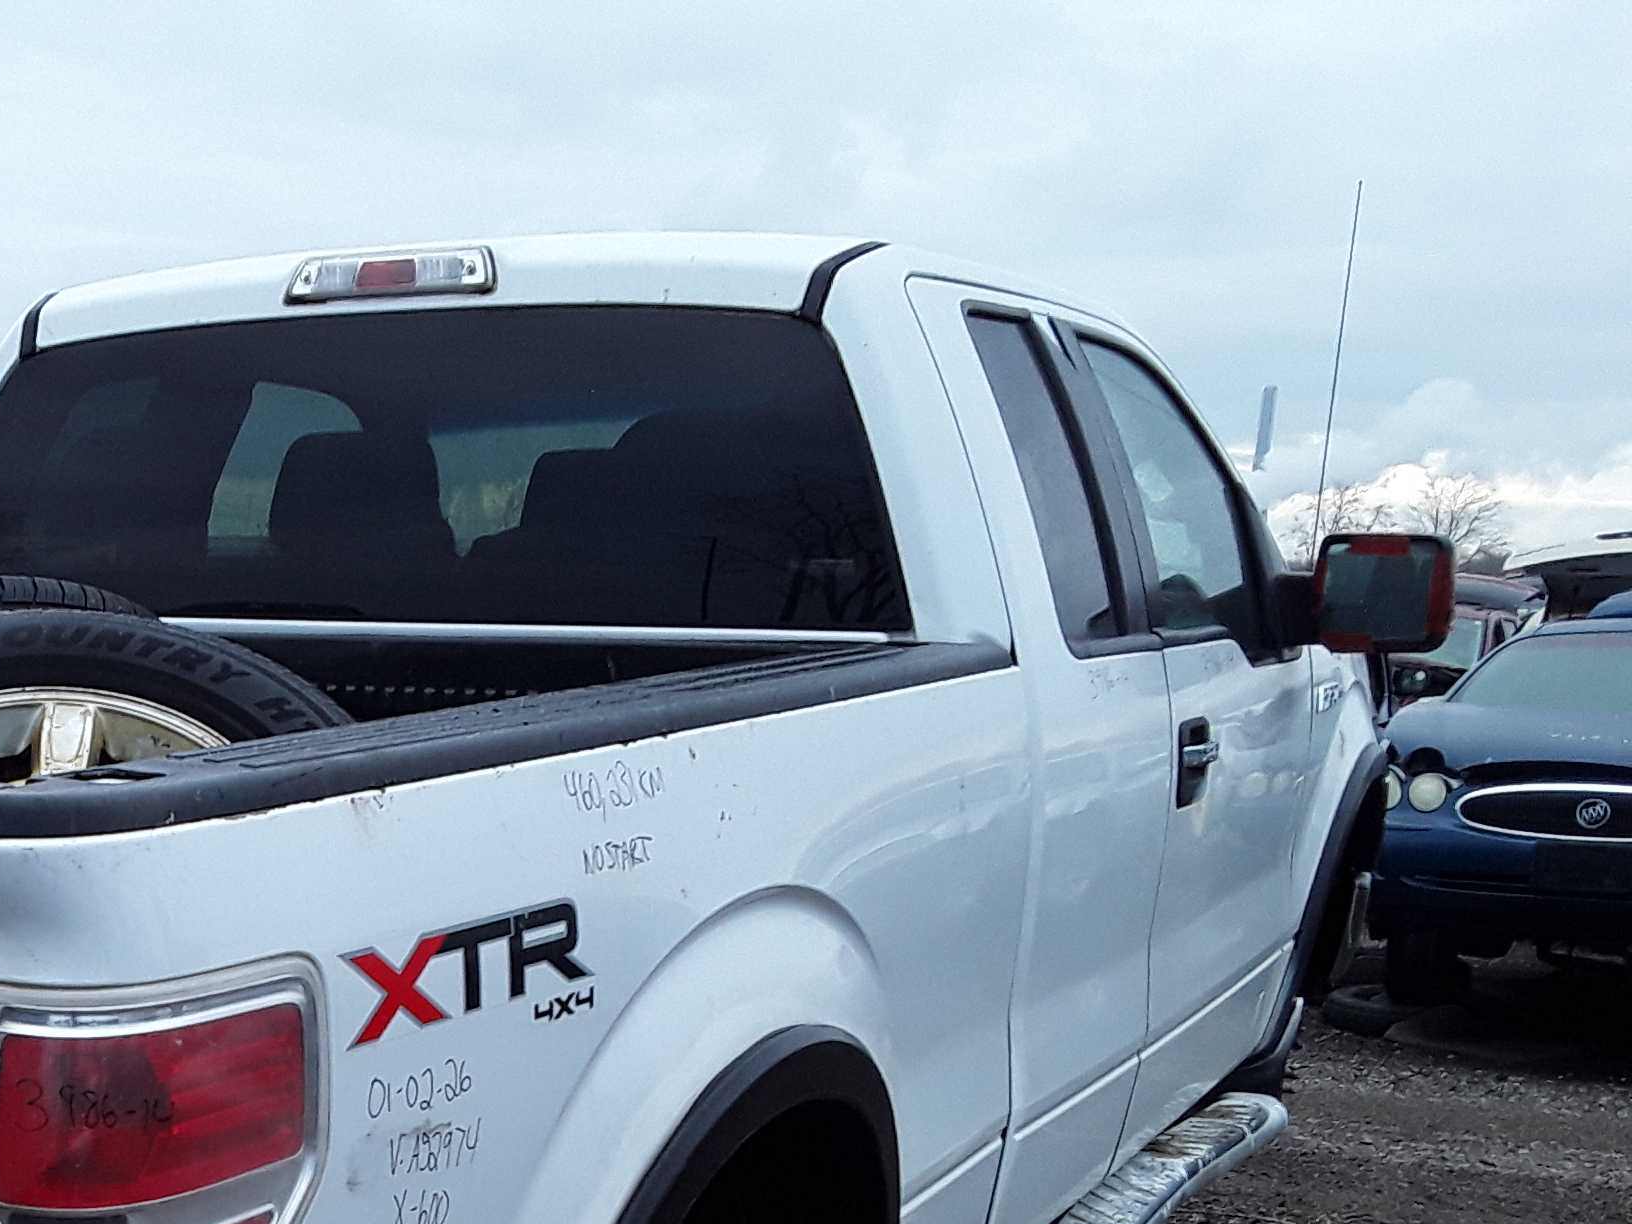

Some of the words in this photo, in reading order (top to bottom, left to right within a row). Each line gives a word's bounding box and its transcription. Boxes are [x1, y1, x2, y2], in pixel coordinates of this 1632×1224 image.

[336, 897, 596, 1052] XTR
[14, 1077, 177, 1137] 3986-14
[367, 1058, 473, 1120] 01-02-26
